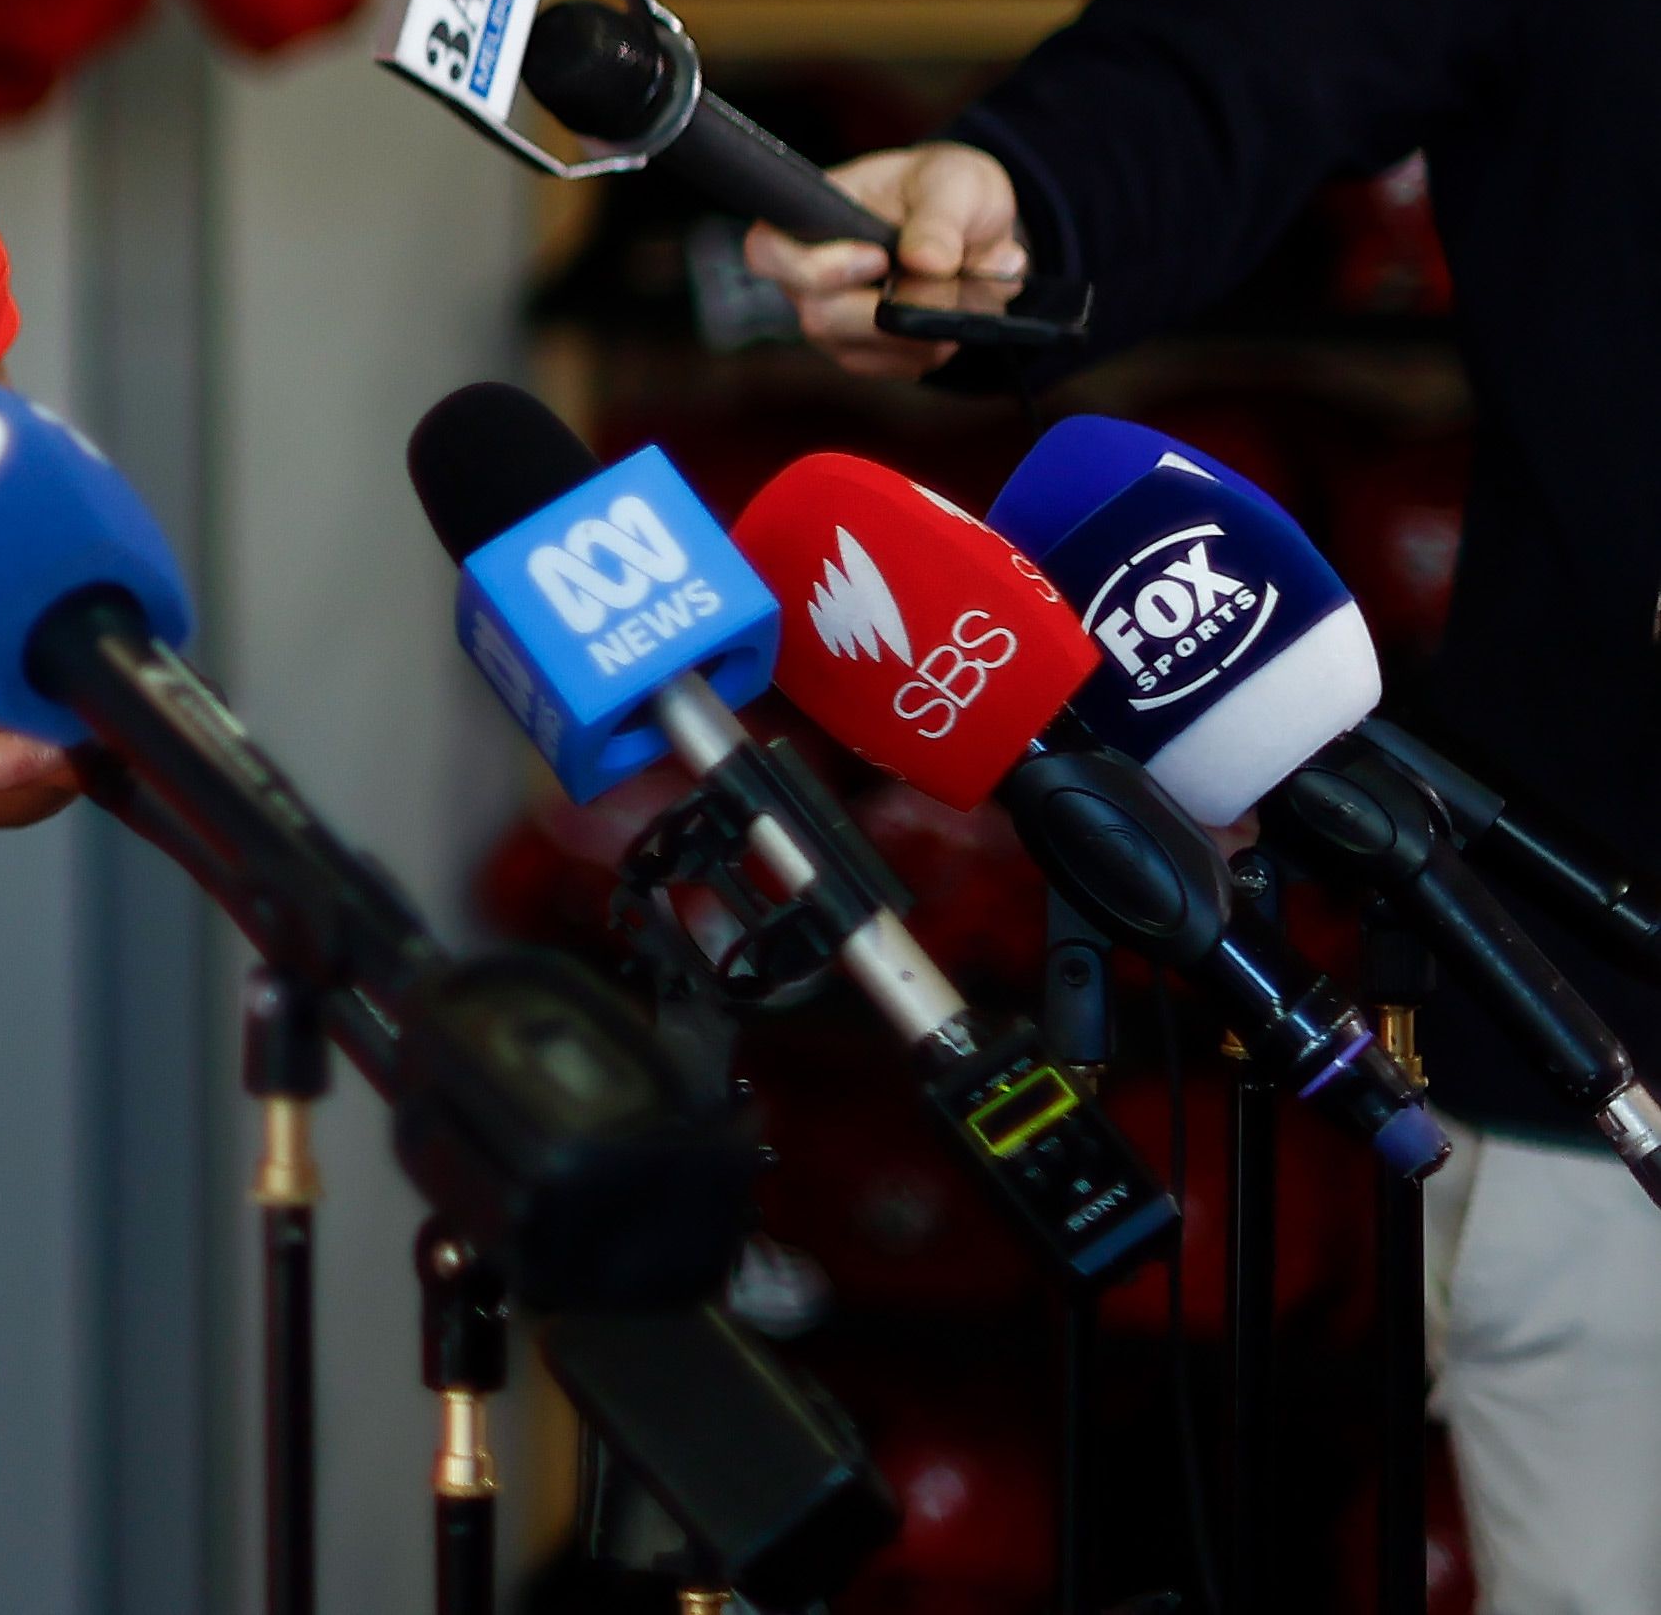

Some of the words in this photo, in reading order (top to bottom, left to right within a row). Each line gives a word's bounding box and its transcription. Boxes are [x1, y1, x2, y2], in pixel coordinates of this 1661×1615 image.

[586, 578, 722, 677] NEWS
[1094, 540, 1245, 678] FOX
[1135, 588, 1258, 693] SPORTS
[892, 608, 1019, 740] SBS
